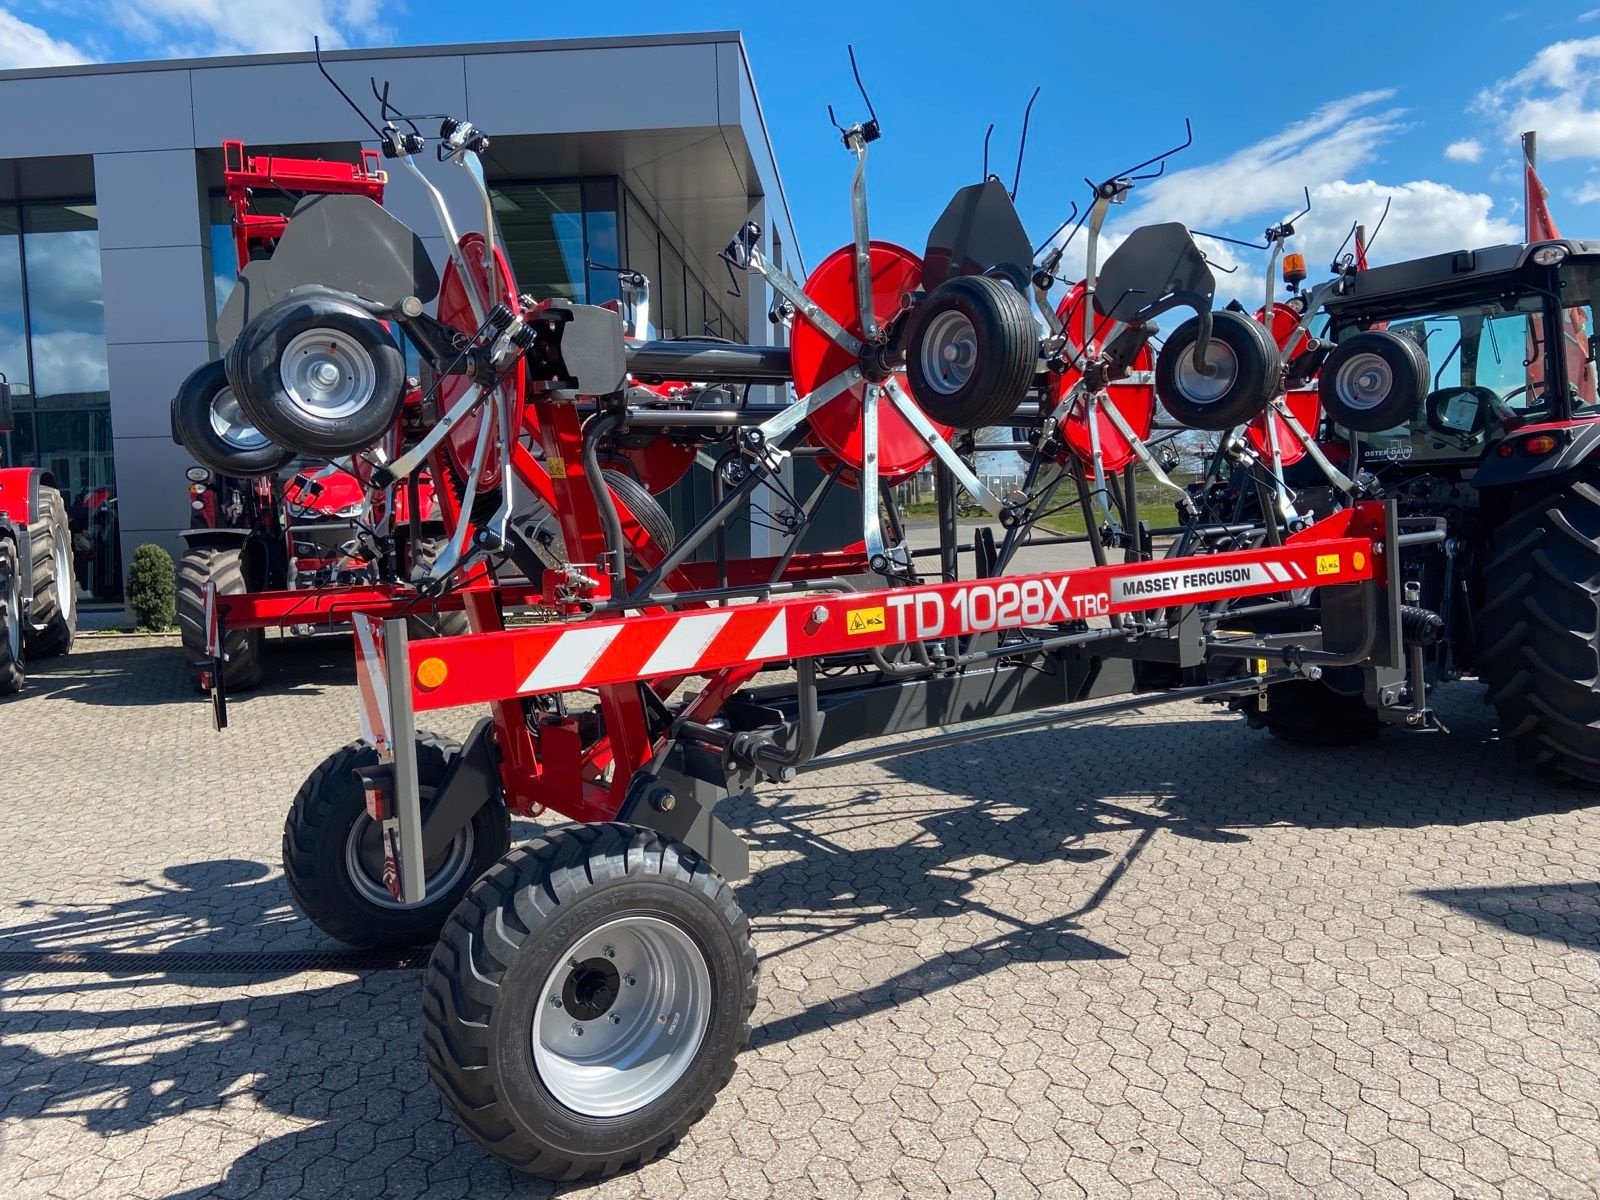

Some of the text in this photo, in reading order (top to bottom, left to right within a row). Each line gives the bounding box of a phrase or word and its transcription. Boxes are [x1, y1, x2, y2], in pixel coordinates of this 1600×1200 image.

[1122, 567, 1251, 596] MASSEY FERGUSON
[886, 576, 1110, 641] TD 1028X TRC
